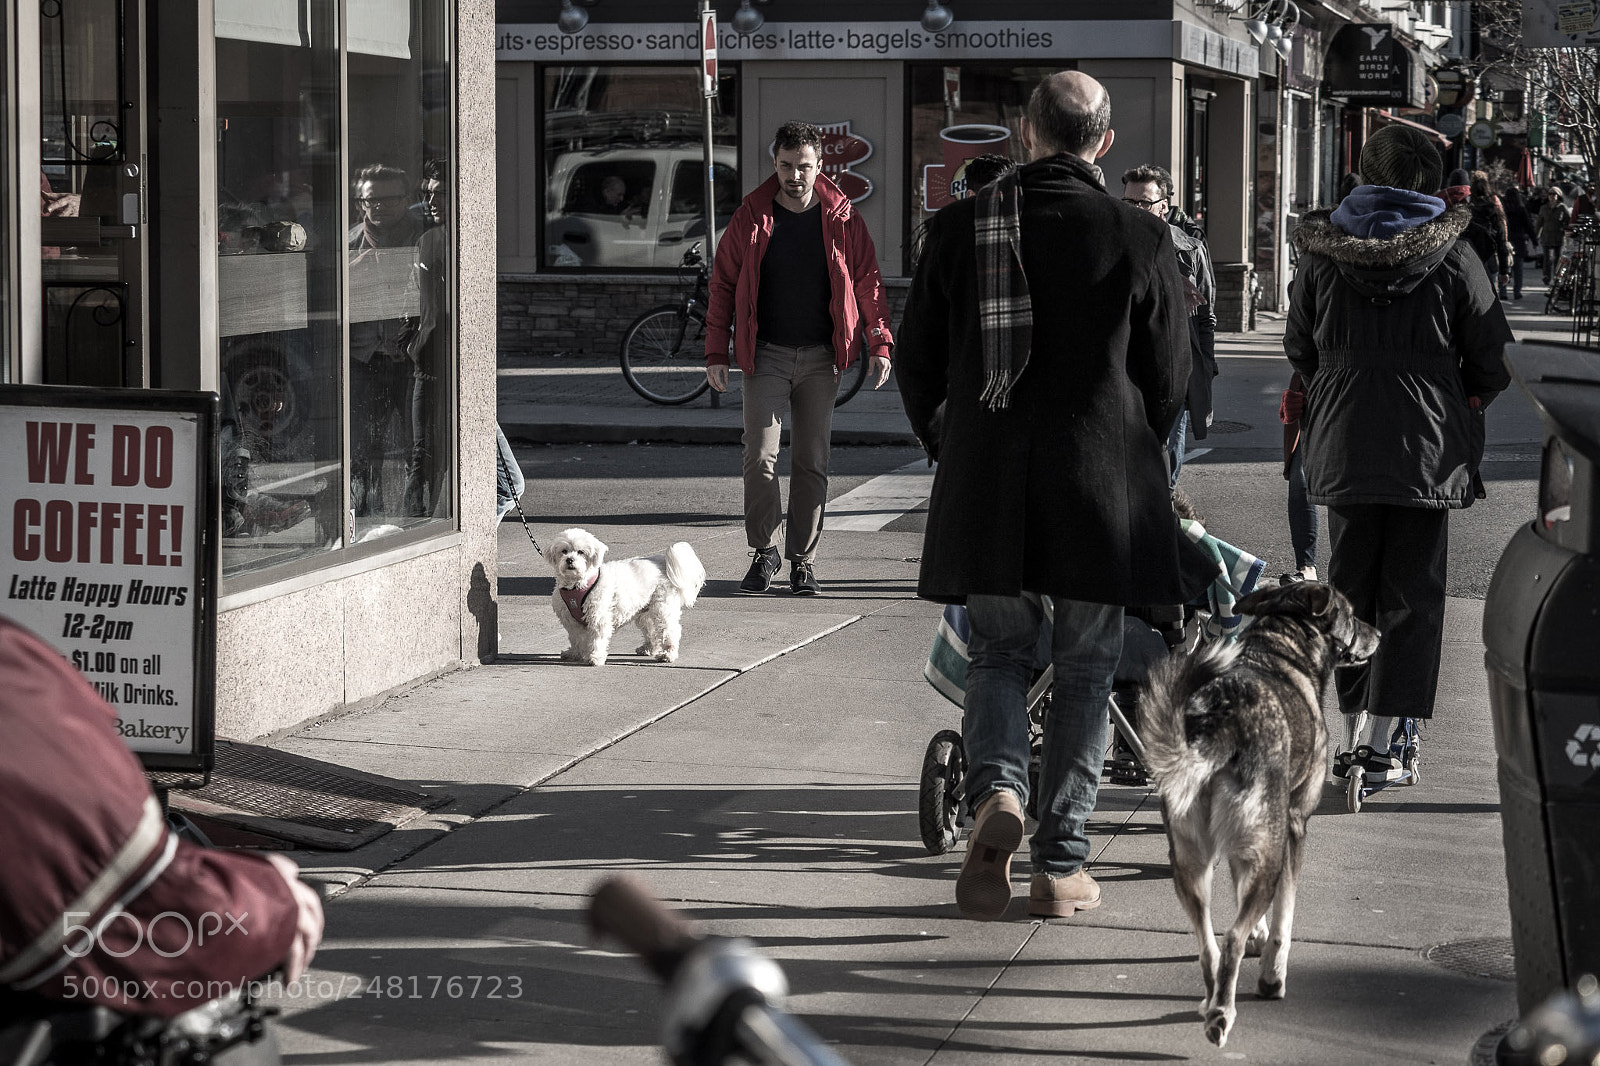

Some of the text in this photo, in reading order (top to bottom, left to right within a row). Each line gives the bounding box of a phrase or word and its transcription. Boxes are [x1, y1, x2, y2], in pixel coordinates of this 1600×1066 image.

[534, 34, 634, 56] espresso
[646, 29, 778, 50] sandiches
[789, 29, 835, 49] latte
[847, 28, 922, 54] bagels
[934, 27, 1053, 49] smoothies
[1359, 54, 1391, 62] EARLY
[1359, 72, 1389, 80] WORM
[26, 420, 174, 489] WE DO
[13, 498, 184, 567] COFFEE!
[8, 574, 188, 608] Latte Happy Hours
[61, 612, 134, 644] 12-2pm
[72, 649, 161, 676] $1.00 on all
[123, 682, 179, 706] Drinks.
[113, 718, 190, 744] Bakery
